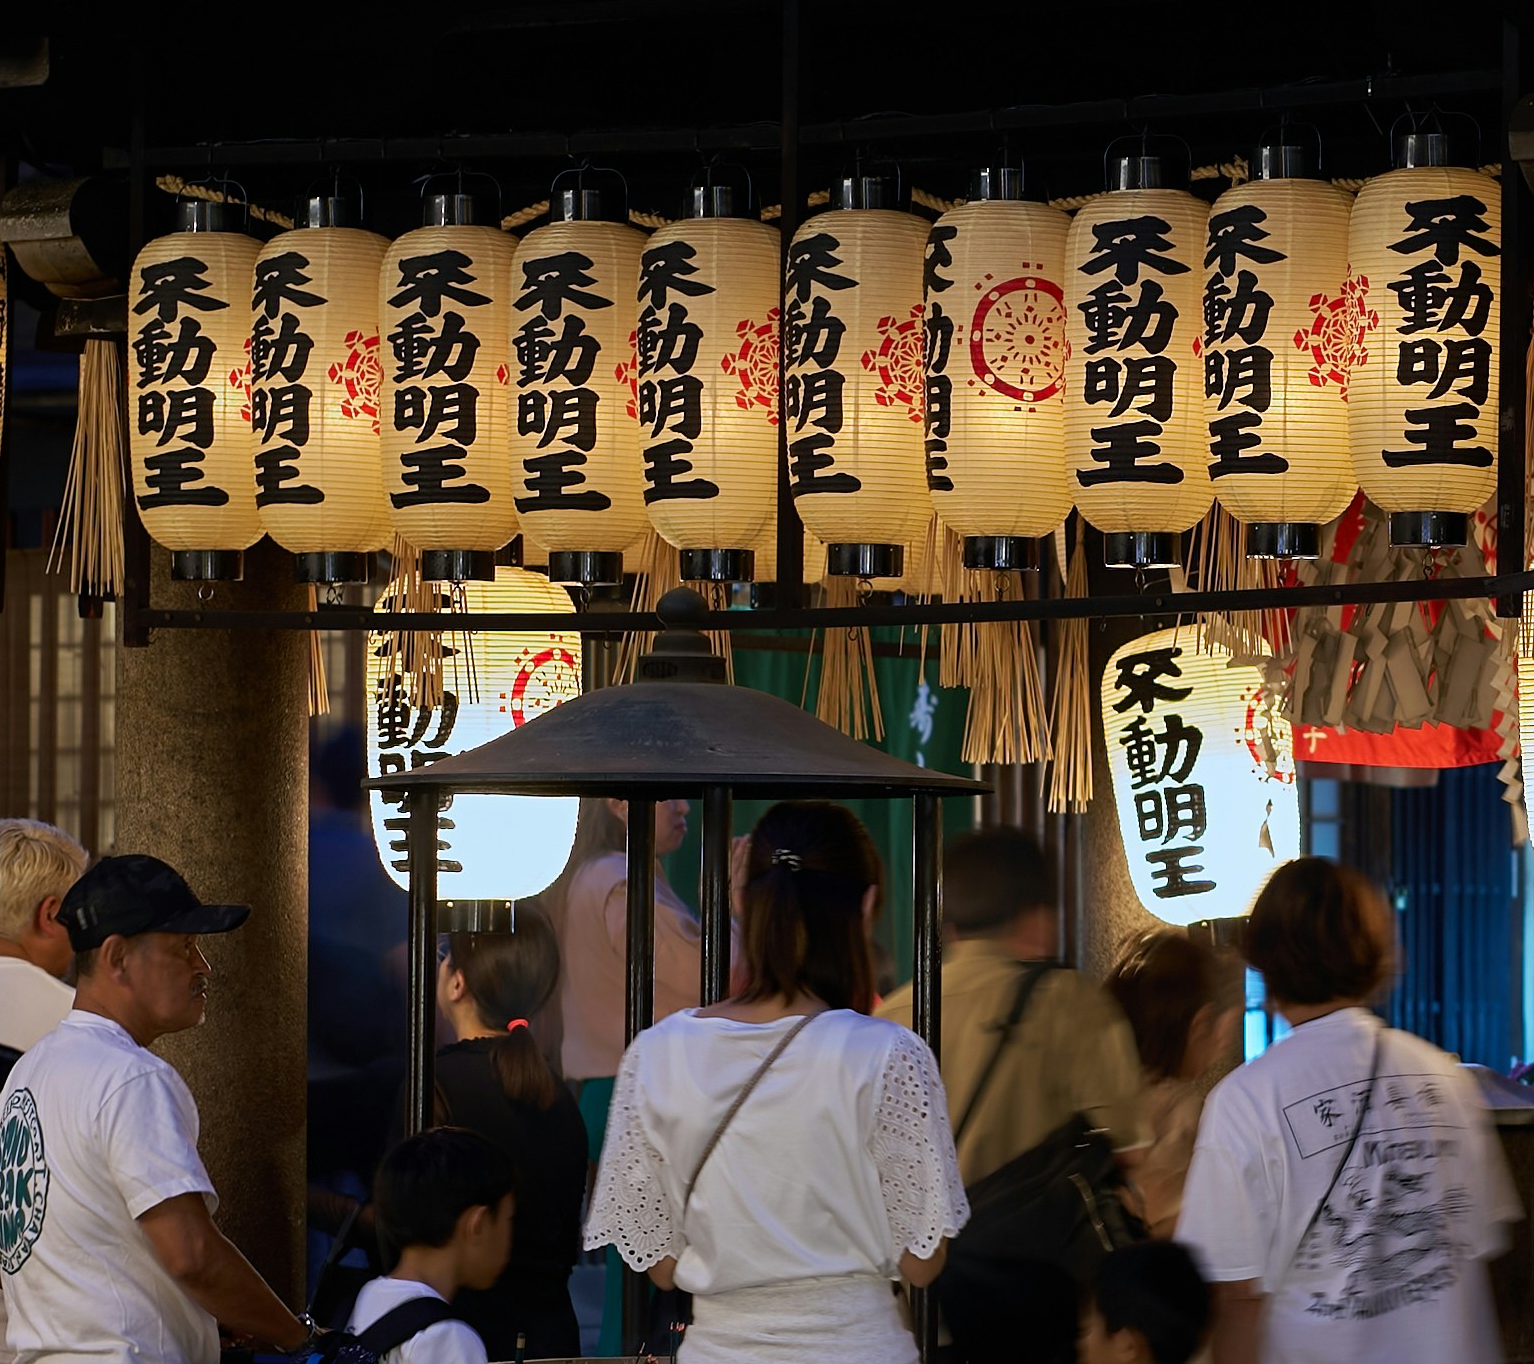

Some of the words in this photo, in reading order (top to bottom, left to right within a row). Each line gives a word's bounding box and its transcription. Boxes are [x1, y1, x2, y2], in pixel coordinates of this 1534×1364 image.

[132, 256, 230, 511] 不動明王
[252, 251, 328, 509] 不動明王
[387, 249, 493, 510] 不動明王
[512, 251, 614, 513] 不動明王
[638, 241, 719, 506] 不動明王
[785, 233, 862, 498] 不動明王
[1076, 215, 1192, 487] 不動明王
[1203, 205, 1289, 480] 不動明王
[1382, 195, 1501, 468] 不動明王
[1113, 647, 1216, 899] 不動明王
